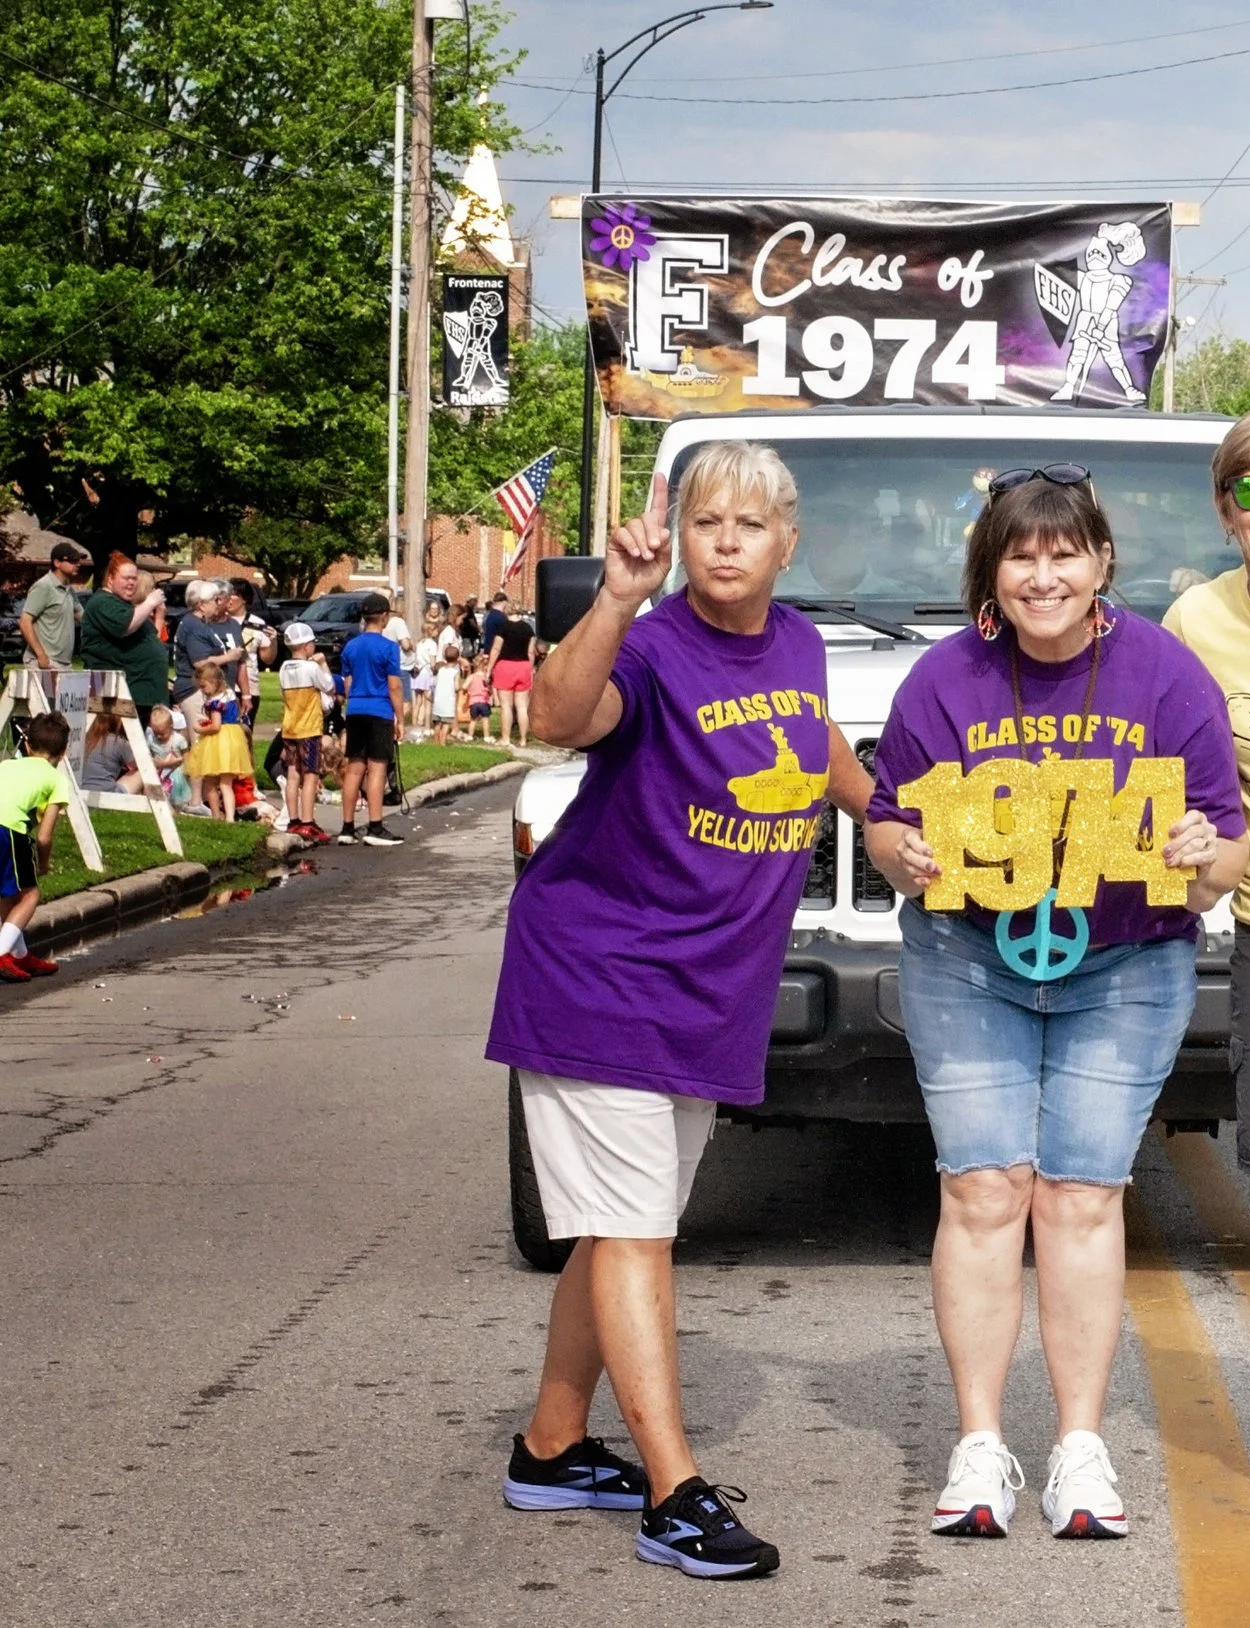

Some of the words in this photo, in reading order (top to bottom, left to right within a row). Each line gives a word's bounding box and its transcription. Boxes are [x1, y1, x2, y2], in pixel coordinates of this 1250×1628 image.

[448, 277, 504, 289] Frontenac
[752, 221, 907, 307] Class
[937, 249, 994, 308] of
[624, 232, 729, 376] F
[1037, 270, 1071, 317] FHS
[447, 319, 465, 342] FHS
[742, 315, 1006, 400] 1974
[697, 693, 773, 734] CLASS
[771, 689, 802, 717] OF
[967, 715, 1058, 753] CLASS
[1062, 714, 1102, 743] OF
[1106, 715, 1146, 752] '74
[688, 804, 771, 855] YELLOW
[897, 756, 1198, 911] 1974
